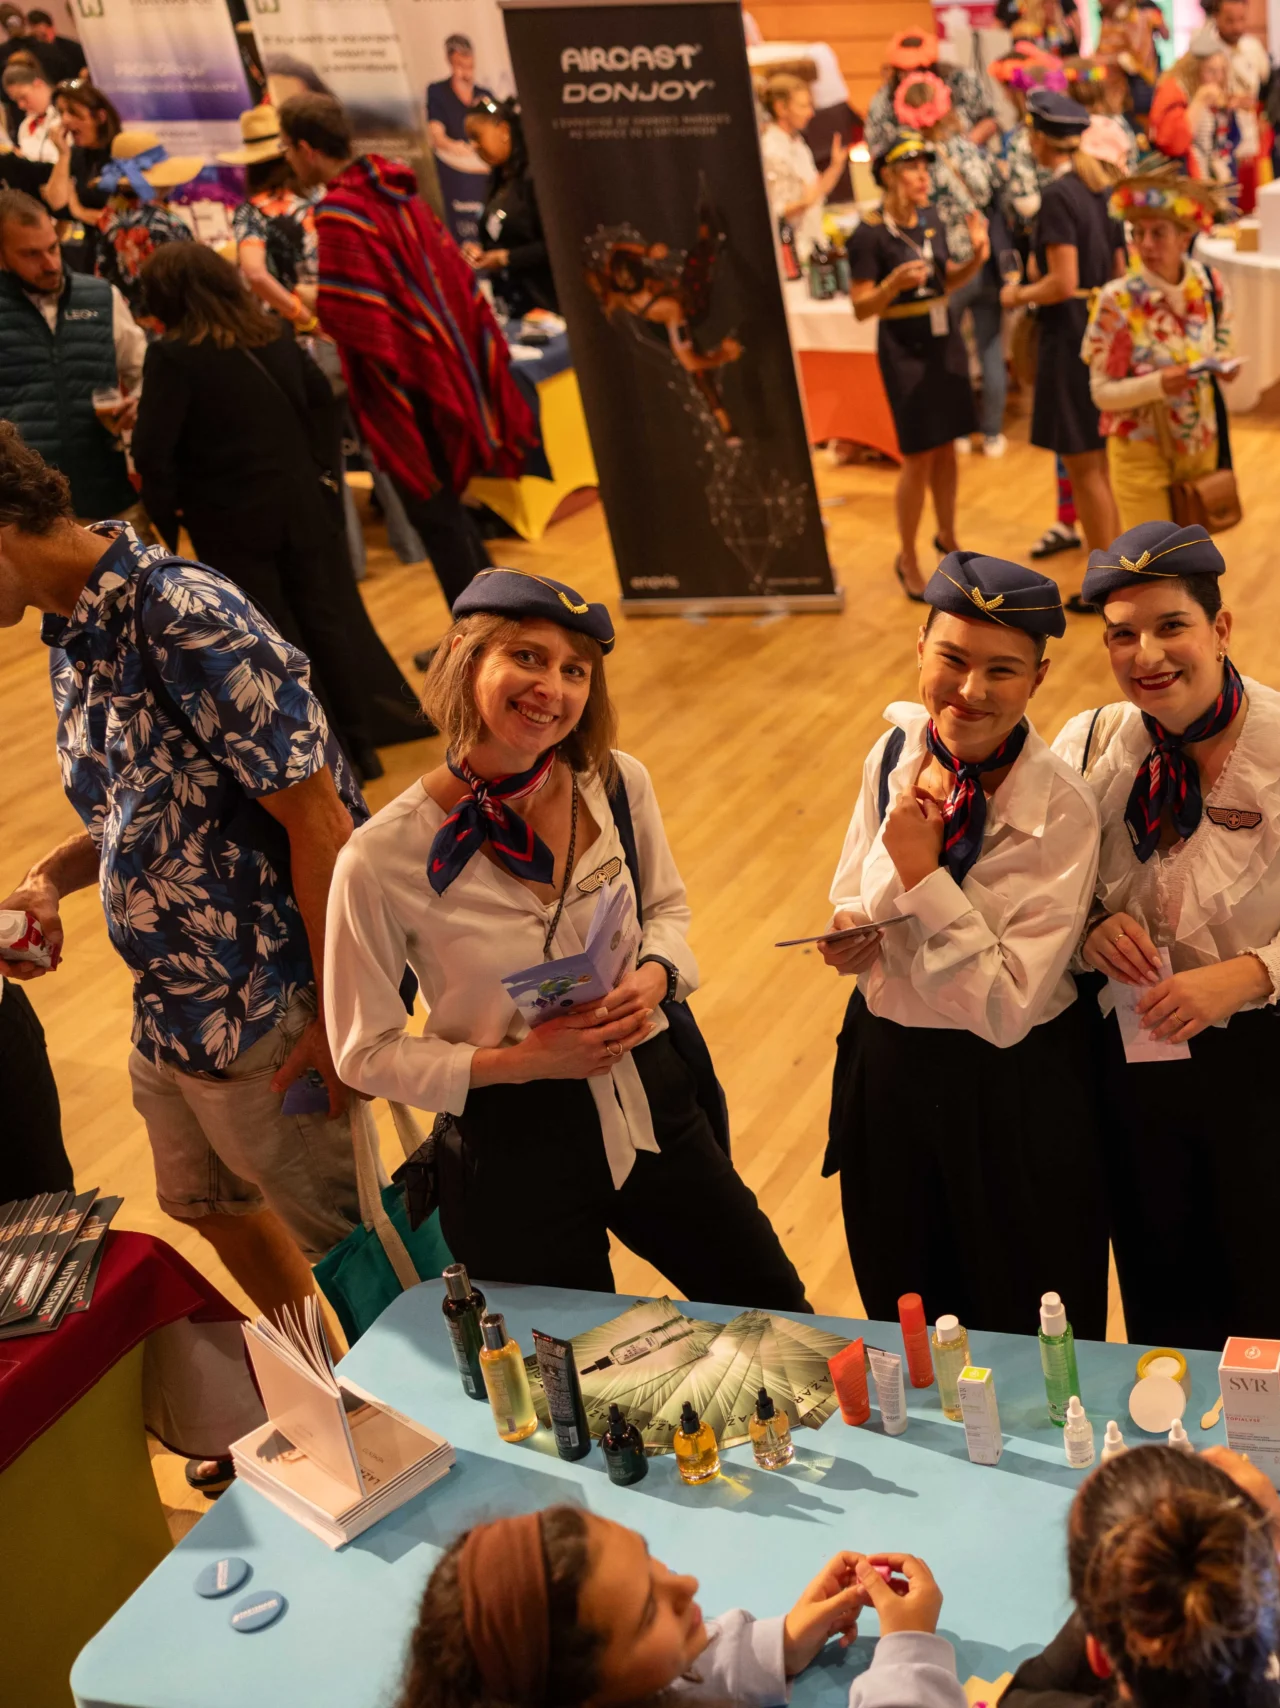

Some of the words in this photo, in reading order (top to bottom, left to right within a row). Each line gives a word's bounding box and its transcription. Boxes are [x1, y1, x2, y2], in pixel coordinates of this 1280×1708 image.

[560, 43, 696, 73] AIRCAST
[562, 80, 707, 104] DONJOY
[38, 1260, 79, 1316] NUTRISENS
[1229, 1377, 1269, 1393] SVR
